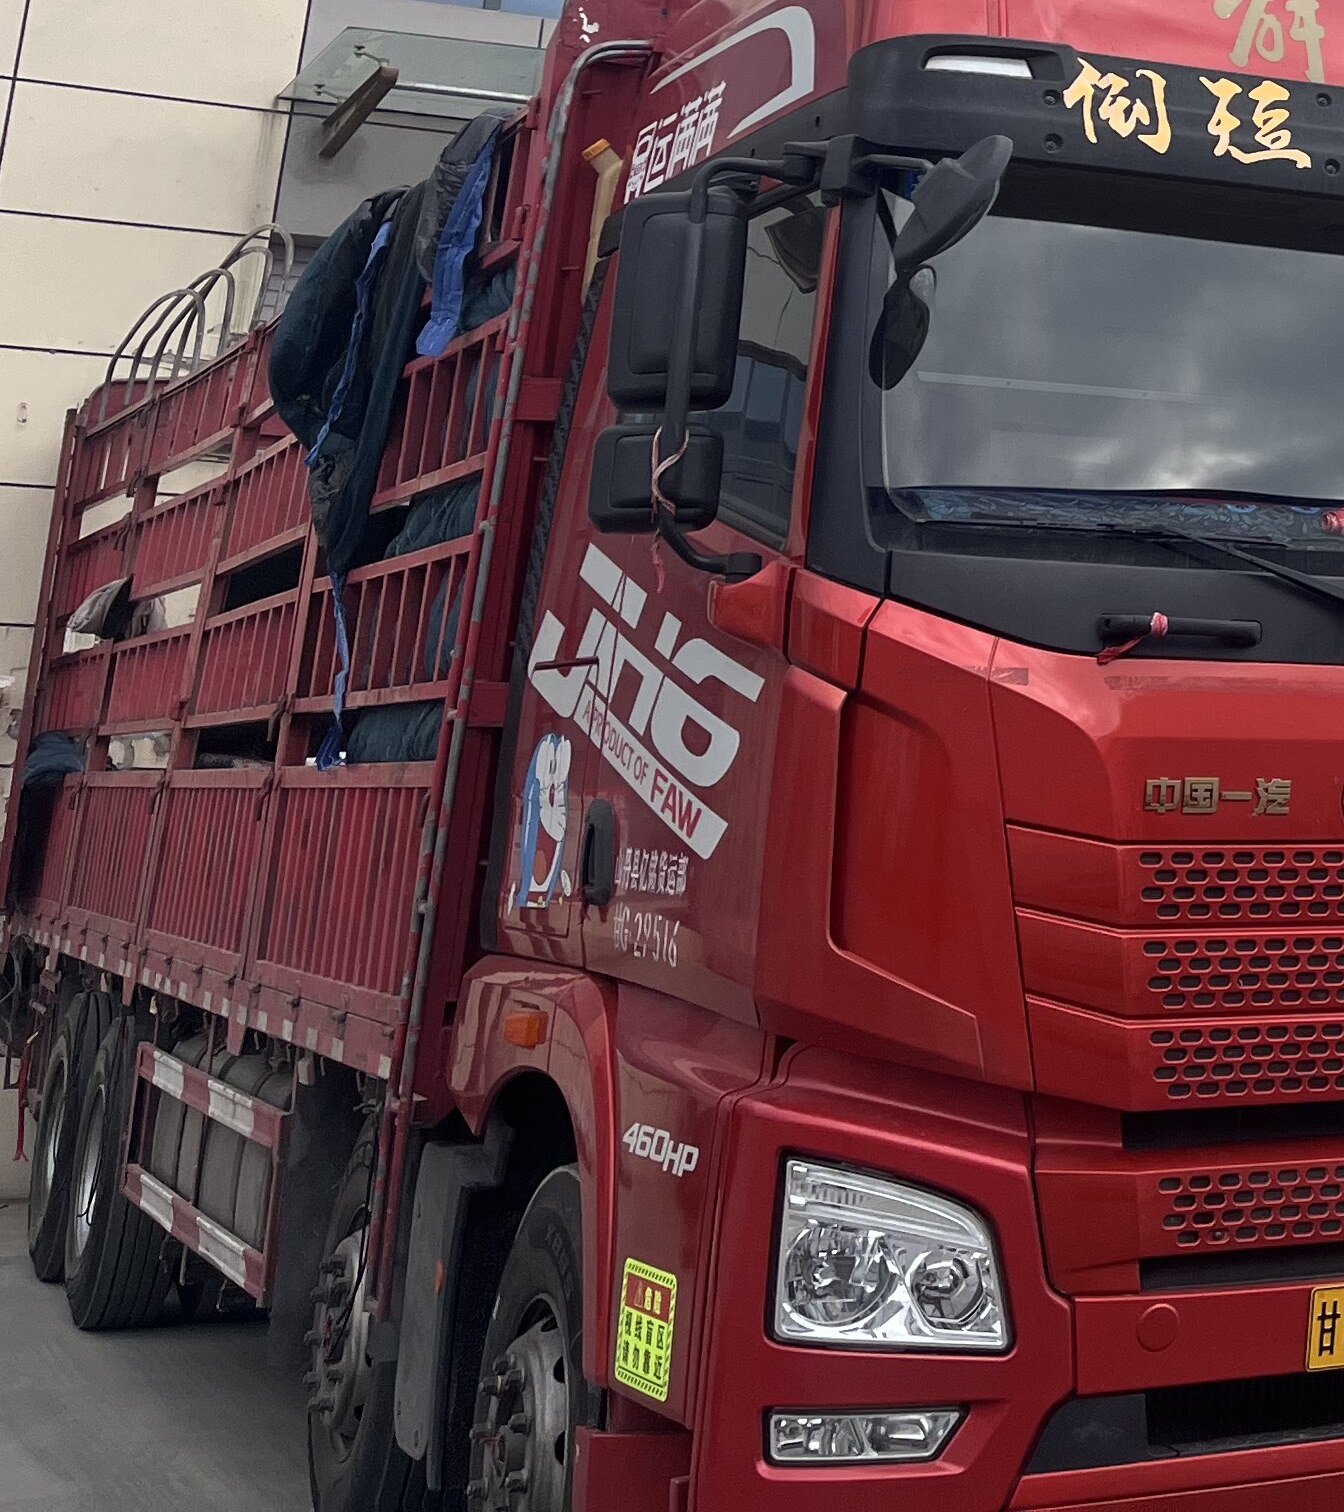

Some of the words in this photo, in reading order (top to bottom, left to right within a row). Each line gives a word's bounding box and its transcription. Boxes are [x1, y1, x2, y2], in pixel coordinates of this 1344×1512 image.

[593, 706, 635, 771] PRODUCT
[633, 755, 649, 785] OF
[651, 768, 703, 839] FAW
[1143, 776, 1292, 816] 中国一汽
[622, 1123, 699, 1177] 460HP
